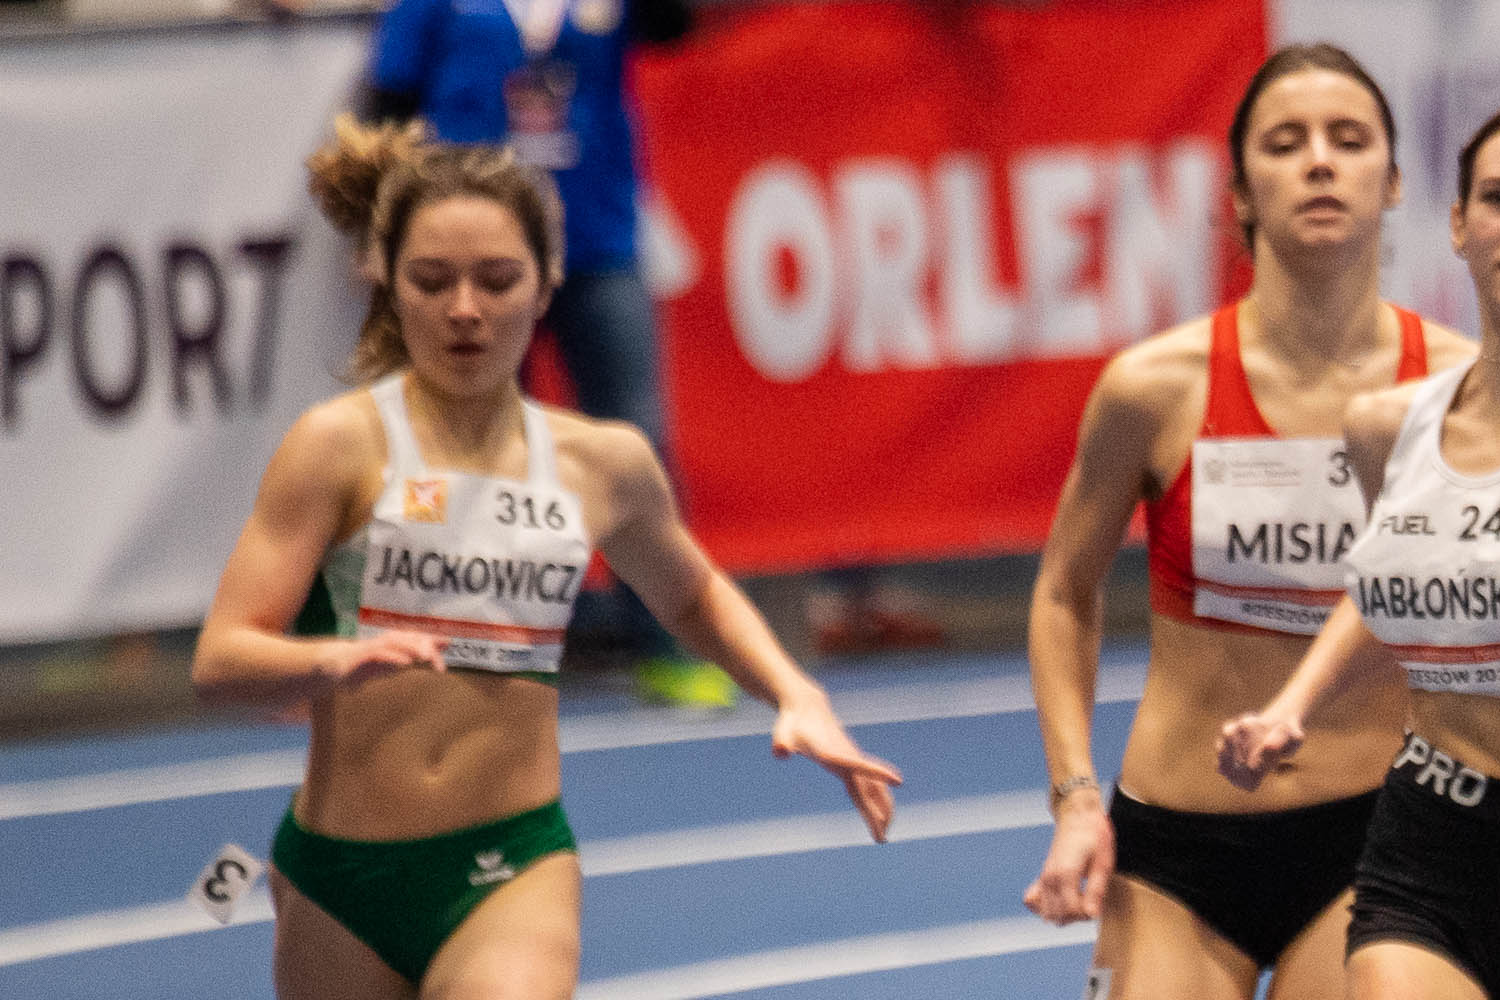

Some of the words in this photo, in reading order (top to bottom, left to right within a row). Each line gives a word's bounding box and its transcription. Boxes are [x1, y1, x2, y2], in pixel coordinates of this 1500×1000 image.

[722, 140, 1222, 381] ORLEN
[496, 490, 566, 531] 316
[374, 547, 578, 604] JACKOWICZ
[1392, 735, 1488, 807] PRO
